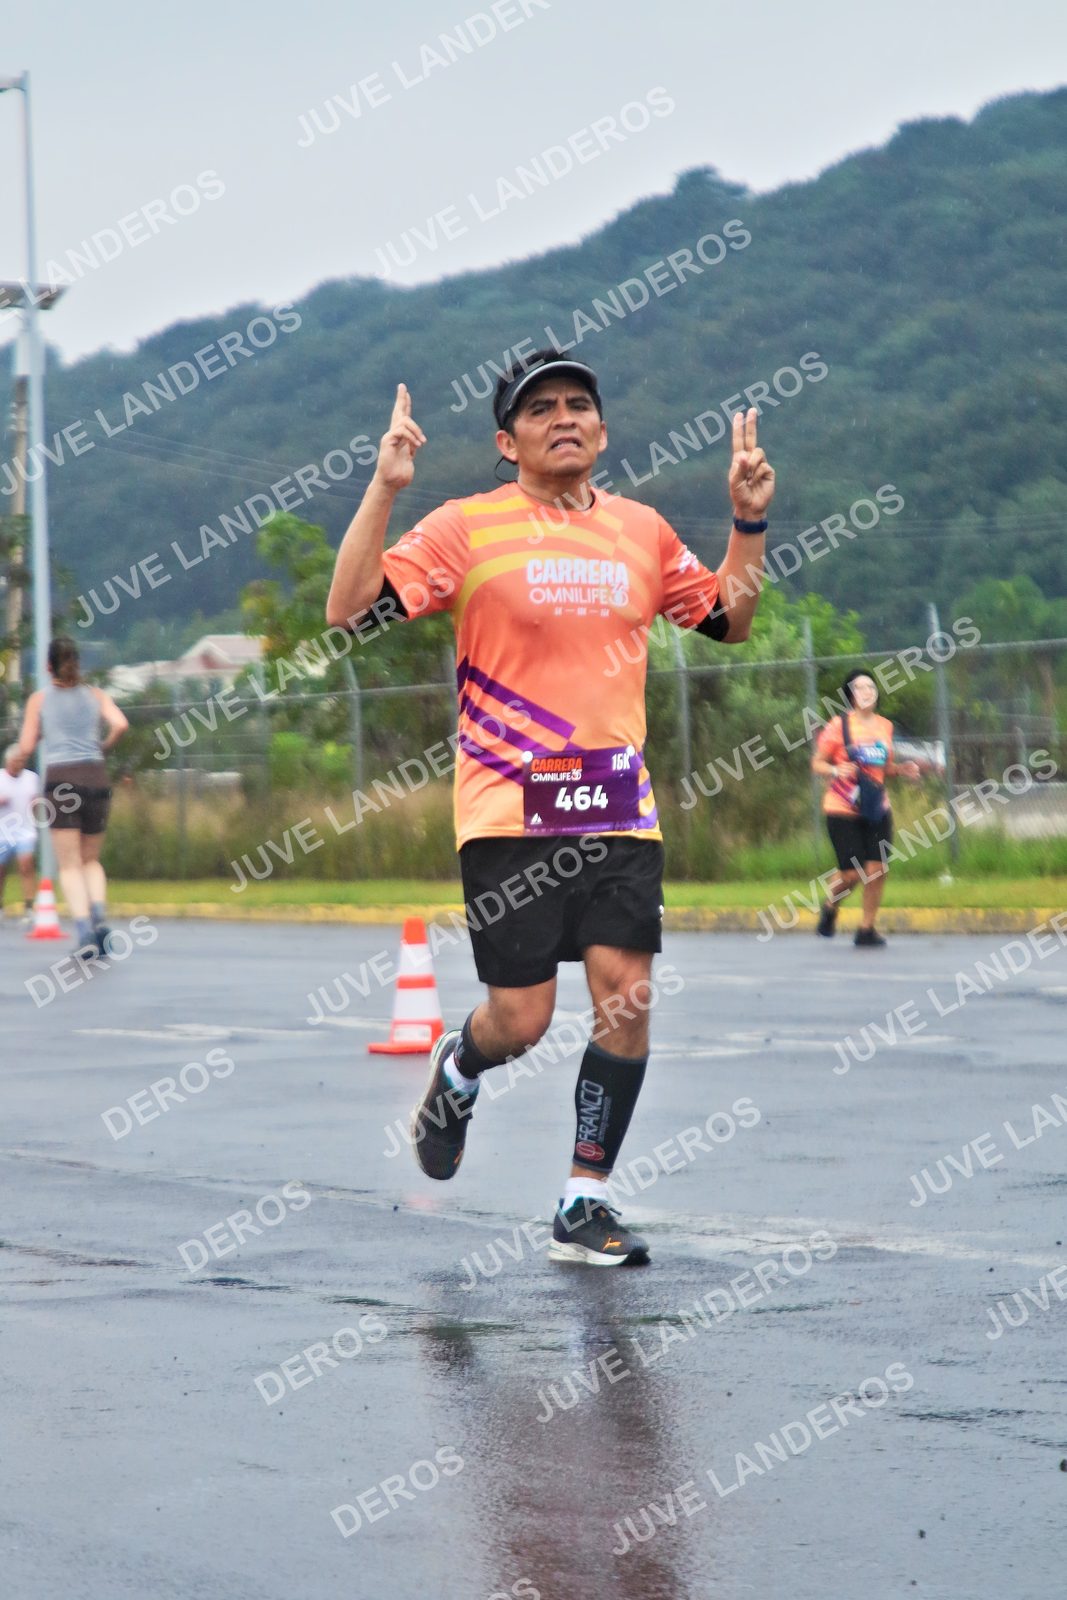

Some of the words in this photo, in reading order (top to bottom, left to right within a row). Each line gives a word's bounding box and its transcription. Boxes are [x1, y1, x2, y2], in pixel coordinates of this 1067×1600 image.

[527, 558, 629, 588] CARRERA
[531, 757, 583, 773] CARRERA
[555, 785, 608, 811] 464
[578, 1079, 604, 1142] FRANCO
